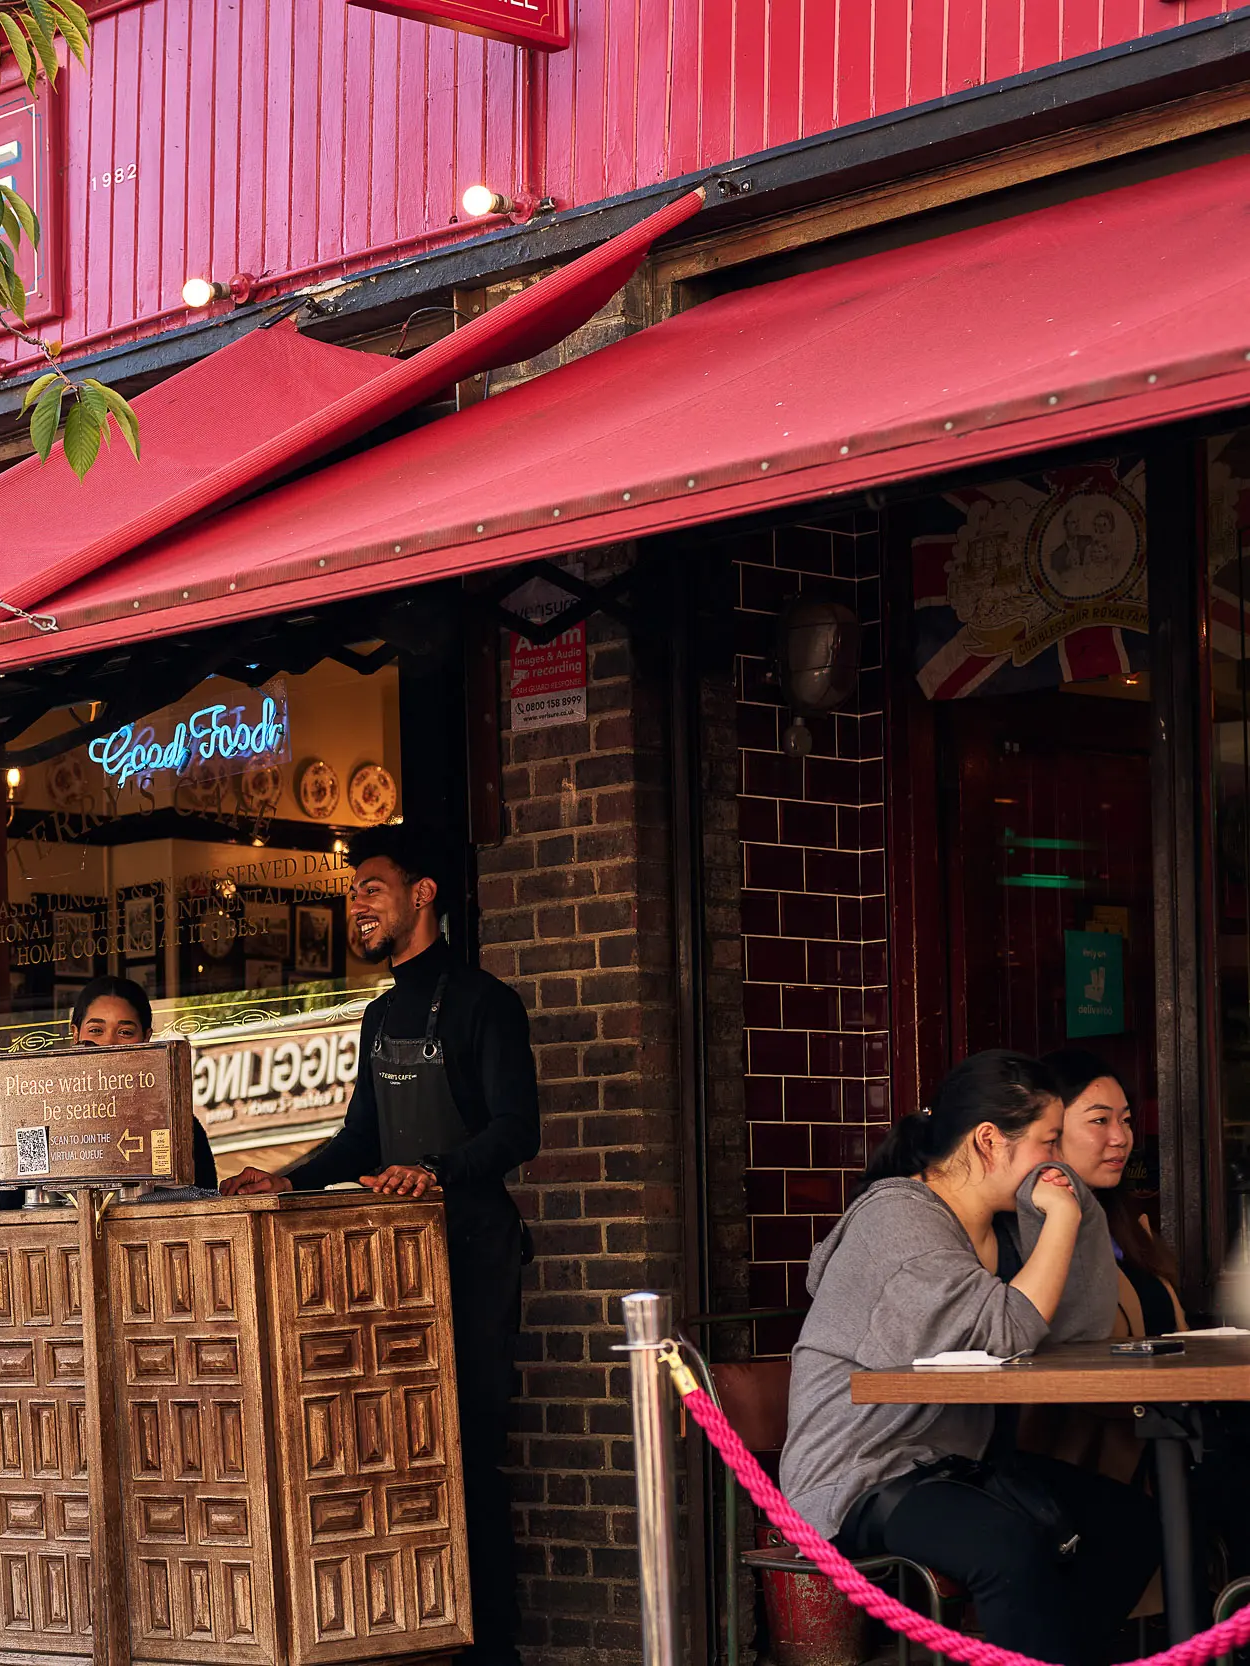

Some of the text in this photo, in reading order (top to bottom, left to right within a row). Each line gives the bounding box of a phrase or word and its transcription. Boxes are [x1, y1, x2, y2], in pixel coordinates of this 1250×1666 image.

[91, 163, 138, 192] 1982
[515, 627, 581, 654] Arm
[1018, 637, 1037, 655] GOD
[1038, 619, 1068, 642] BLESS
[1069, 608, 1089, 625] OUR
[1093, 606, 1125, 620] ROYAL
[514, 647, 582, 668] Images & Audio
[532, 661, 582, 679] recording
[515, 678, 582, 695] 24H GUARD RESPONSE
[523, 708, 575, 722] www.verisure.co.uk
[525, 694, 582, 713] 0800 158 8999
[88, 697, 284, 788] Good Food
[7, 778, 155, 875] TERRY'S
[130, 881, 144, 901] &
[150, 869, 220, 898] SNACKS
[226, 857, 297, 885] SERVED
[303, 850, 351, 875] DAIL
[55, 908, 126, 937] ENGLISH
[154, 888, 287, 924] CONTINENTAL
[17, 942, 67, 966] HOME
[71, 931, 153, 960] COOKING
[158, 922, 186, 948] AT
[225, 916, 269, 939] BEST
[6, 1069, 155, 1097] Please wait here to
[43, 1096, 117, 1121] be seated
[50, 1132, 111, 1146] SCAN TO JOIN THE
[50, 1149, 104, 1162] VIRTUAL QUEUE
